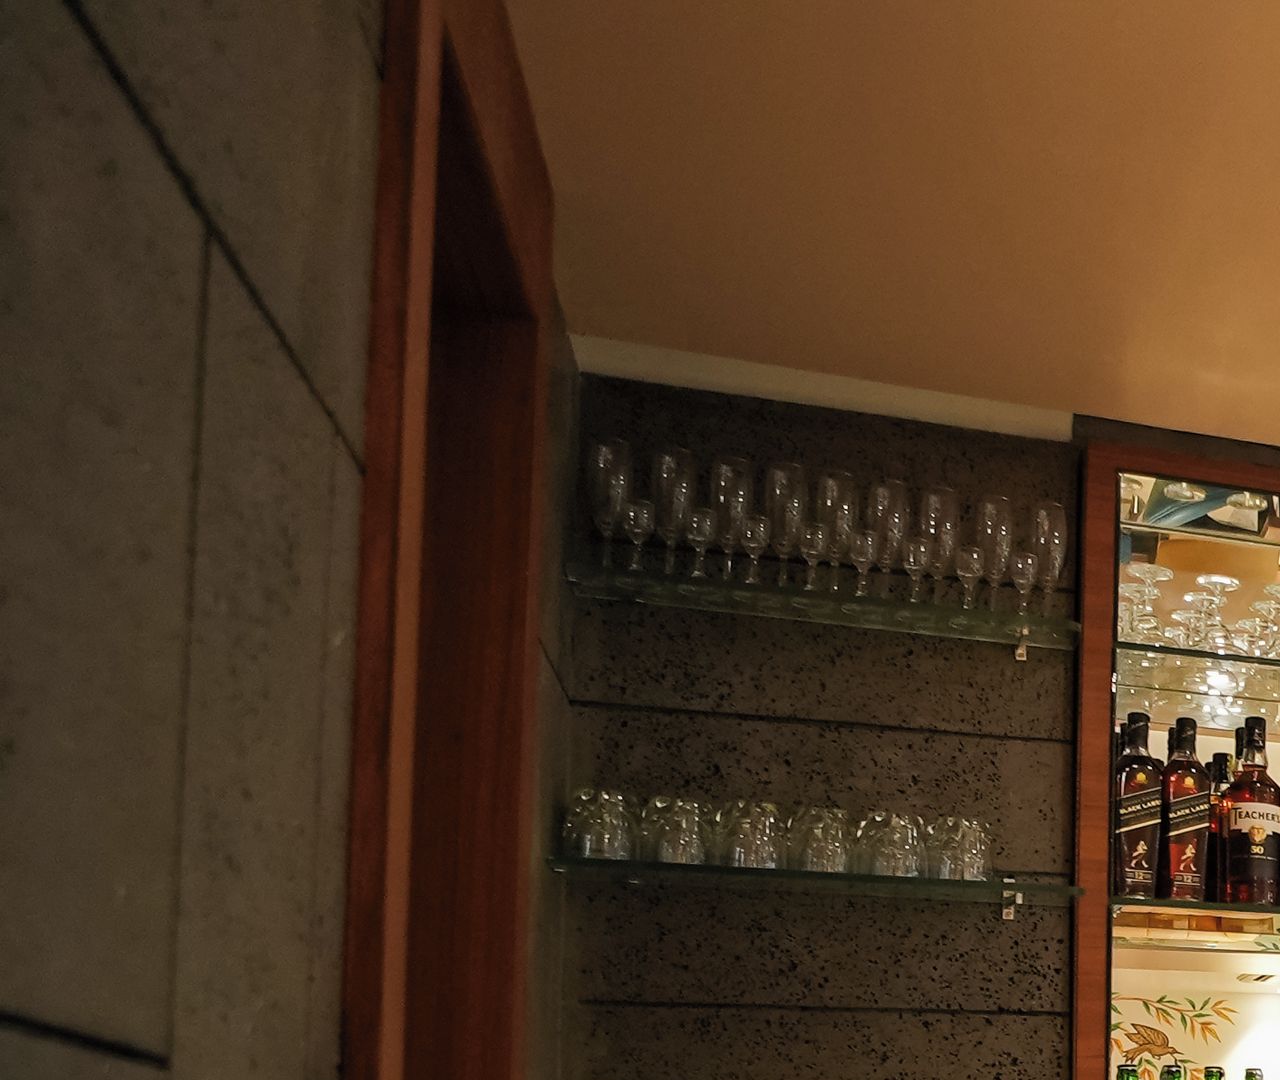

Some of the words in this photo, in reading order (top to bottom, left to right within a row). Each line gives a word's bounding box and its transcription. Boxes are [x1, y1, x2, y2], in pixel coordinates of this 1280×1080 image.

[1250, 845, 1264, 855] 50
[1135, 872, 1143, 880] 12
[1183, 875, 1192, 883] 12
